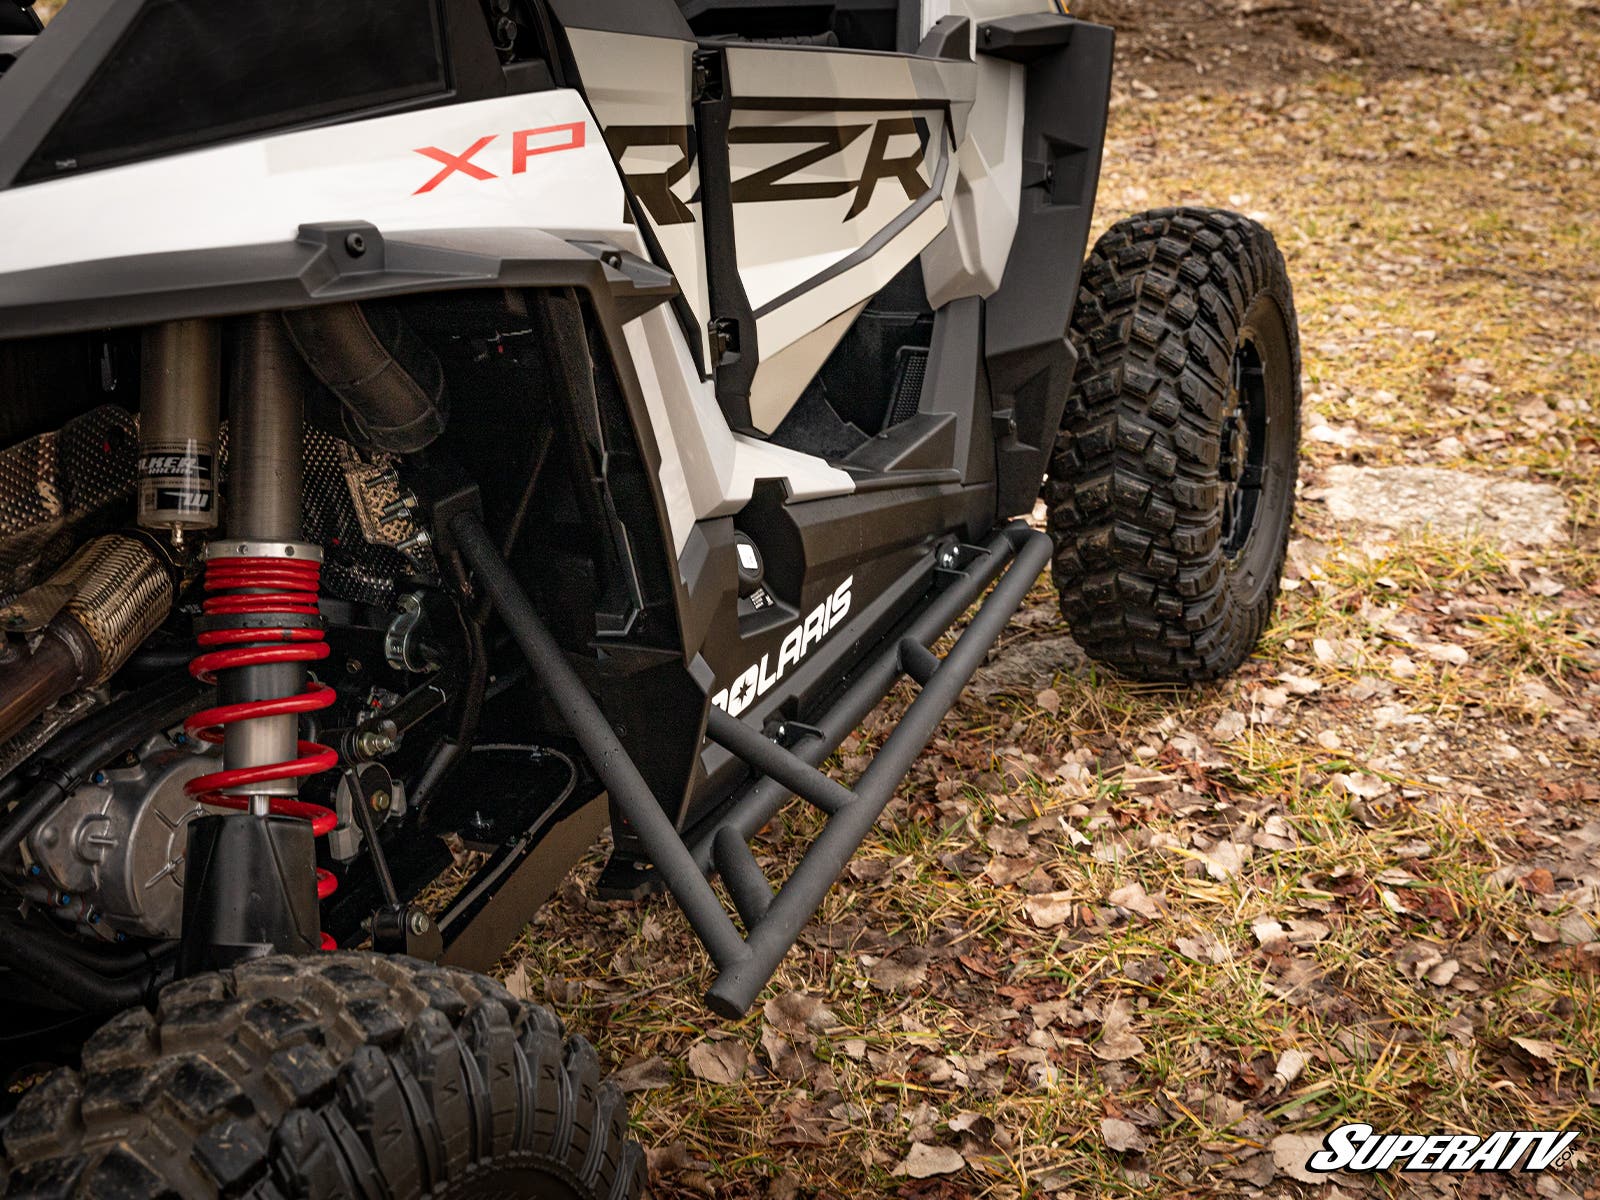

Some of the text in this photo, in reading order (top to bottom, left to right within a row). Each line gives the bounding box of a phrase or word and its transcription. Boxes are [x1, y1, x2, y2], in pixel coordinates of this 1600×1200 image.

[411, 121, 586, 195] XP
[603, 116, 942, 225] RZR
[139, 457, 208, 470] LKER
